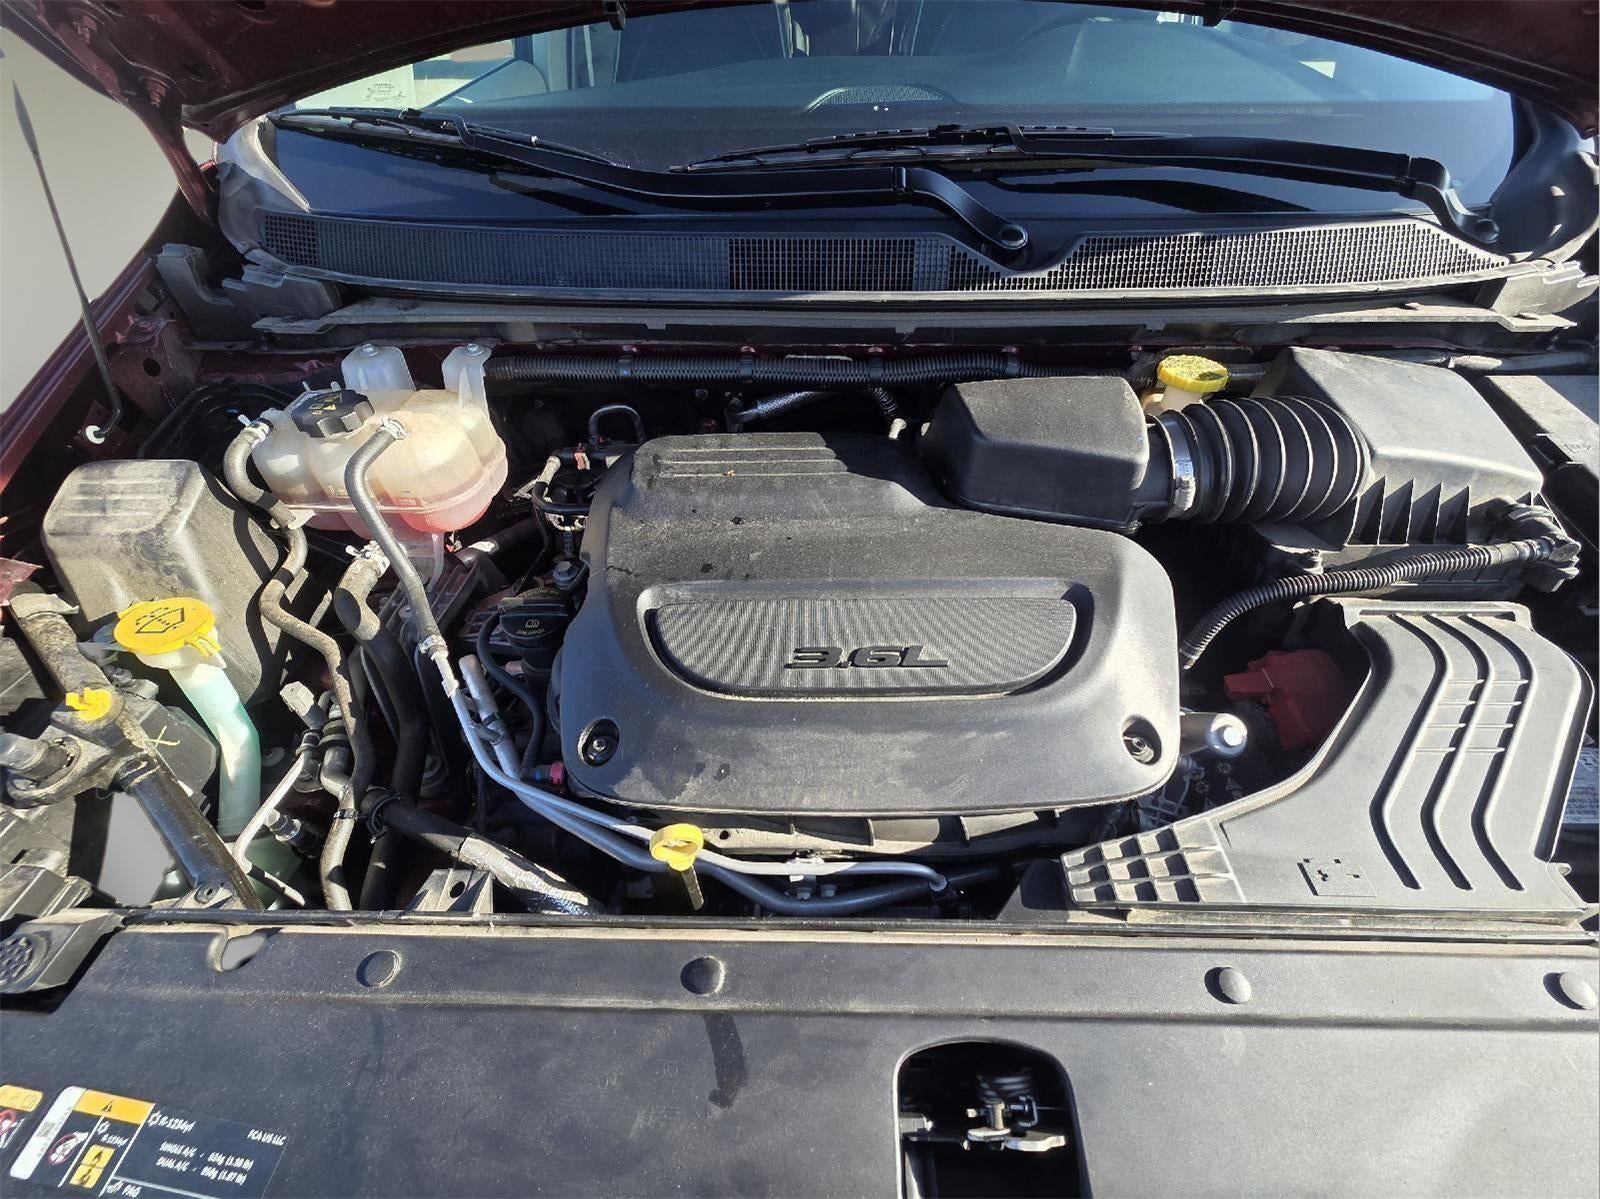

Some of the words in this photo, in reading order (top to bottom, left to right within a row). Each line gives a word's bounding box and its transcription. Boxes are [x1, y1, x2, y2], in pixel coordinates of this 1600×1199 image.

[783, 645, 950, 669] 3.6L
[246, 1128, 263, 1141] FCA
[261, 1132, 275, 1144] US
[271, 1134, 287, 1146] LLC
